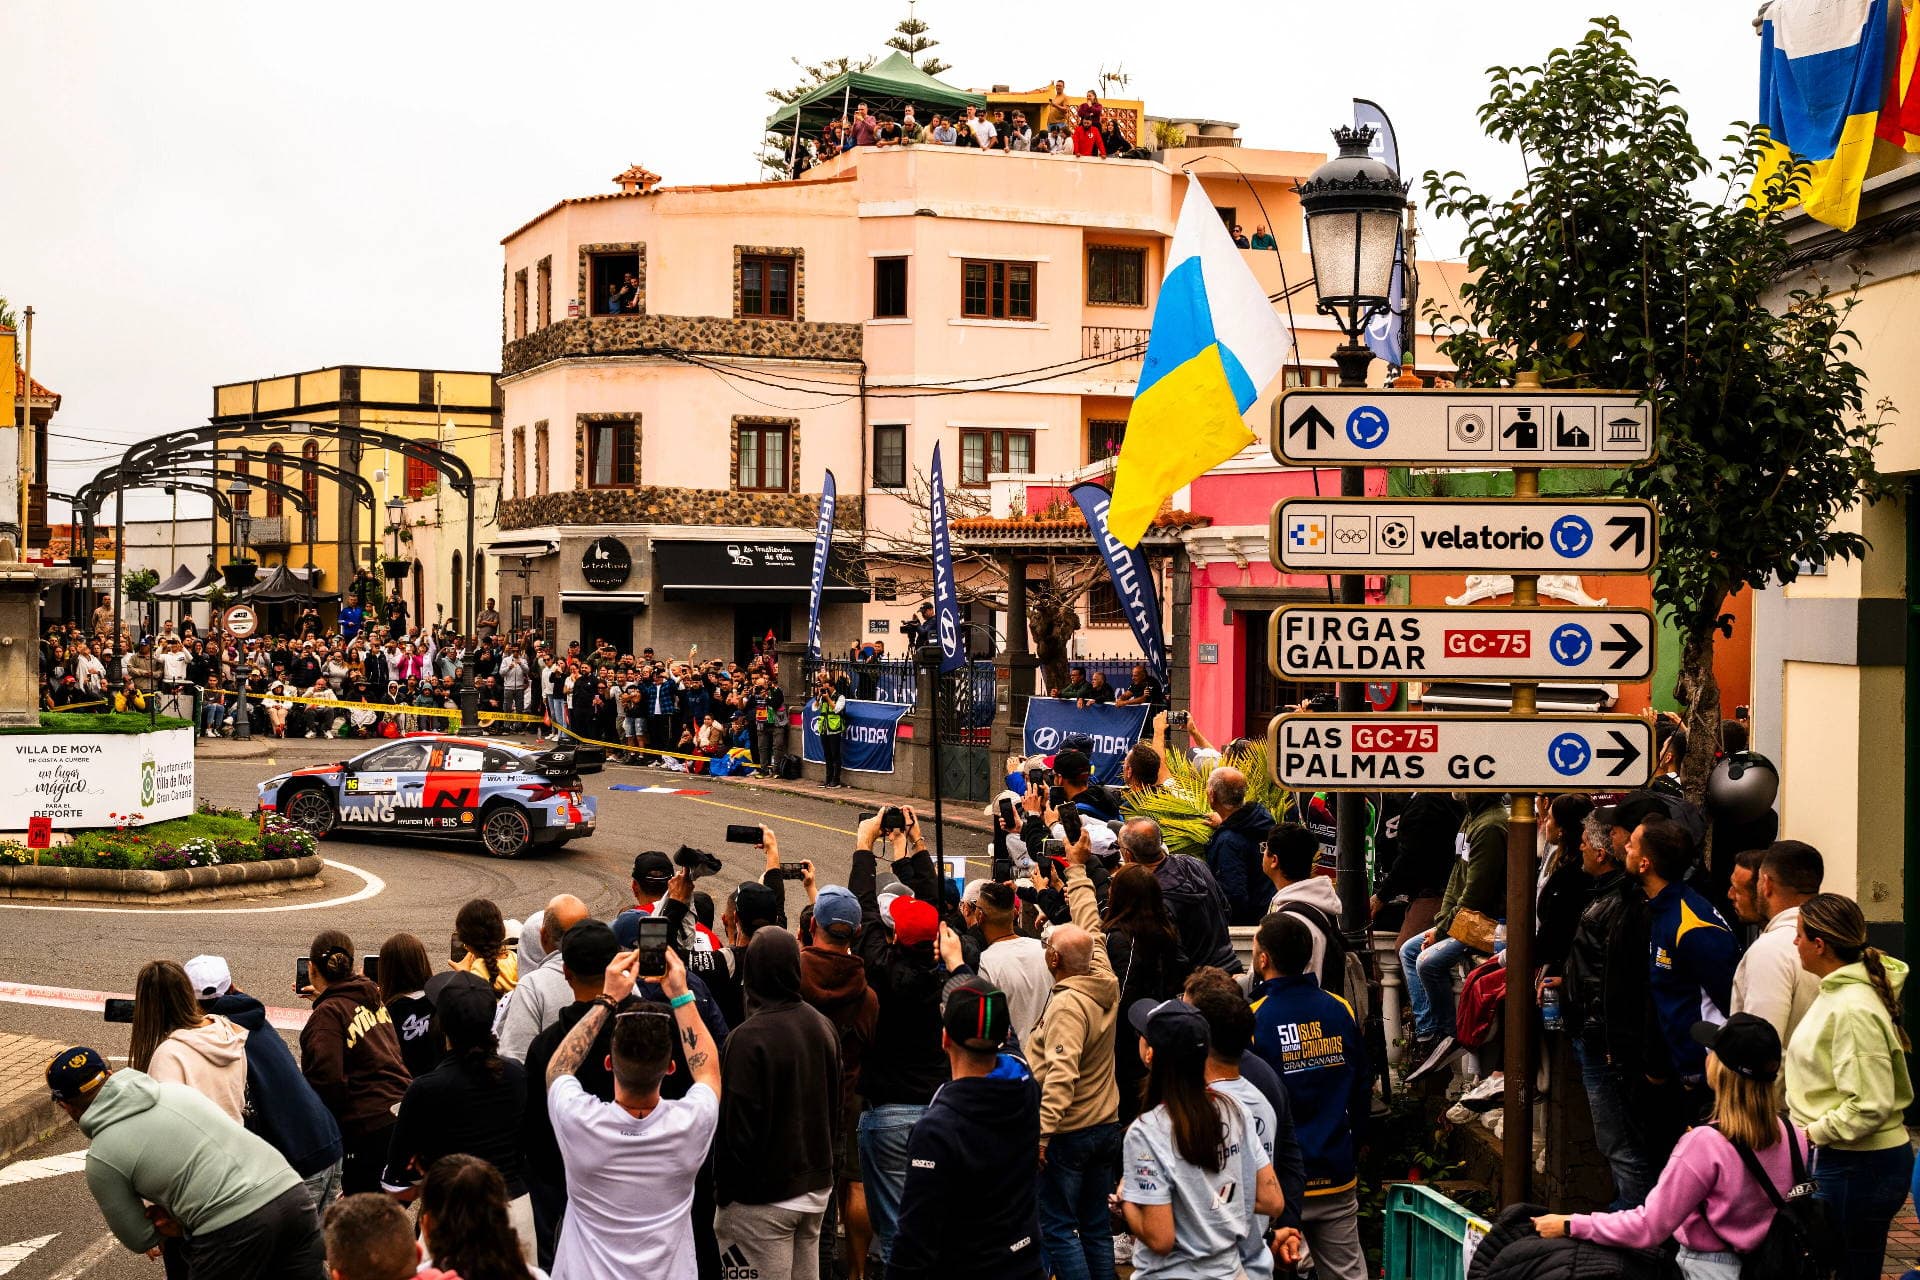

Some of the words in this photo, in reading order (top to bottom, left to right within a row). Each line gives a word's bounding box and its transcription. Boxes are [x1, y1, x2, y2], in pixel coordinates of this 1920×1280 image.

[931, 470, 949, 602] HYUNDAI
[1420, 524, 1544, 550] velatorio
[1286, 616, 1421, 642] FIRGAS
[1448, 633, 1527, 654] GC-75
[1286, 640, 1426, 670] GÁLDAR
[1286, 726, 1342, 749] LAS
[1355, 728, 1434, 749] GC-75
[16, 745, 49, 755] VILLA
[52, 745, 67, 754] DE
[70, 745, 103, 754] MOYA
[54, 764, 80, 784] lugar
[1285, 753, 1425, 779] PALMAS
[1447, 754, 1496, 780] GC
[35, 778, 87, 803] mágico
[156, 777, 169, 790] Villa
[169, 775, 177, 788] de
[178, 773, 192, 787] Moya
[156, 792, 170, 804] Gran
[171, 789, 192, 801] Canaria
[374, 791, 421, 808] NAM
[33, 809, 83, 818] DEPORTE
[340, 806, 396, 823] YANG
[424, 817, 458, 827] MOBIS
[1277, 1022, 1300, 1045] 50
[1298, 1021, 1322, 1041] ISLAS
[1282, 1051, 1301, 1062] RALLY
[1302, 1035, 1343, 1059] CANARIAS
[1283, 1060, 1307, 1070] GRAN
[1307, 1054, 1345, 1067] CANARIA
